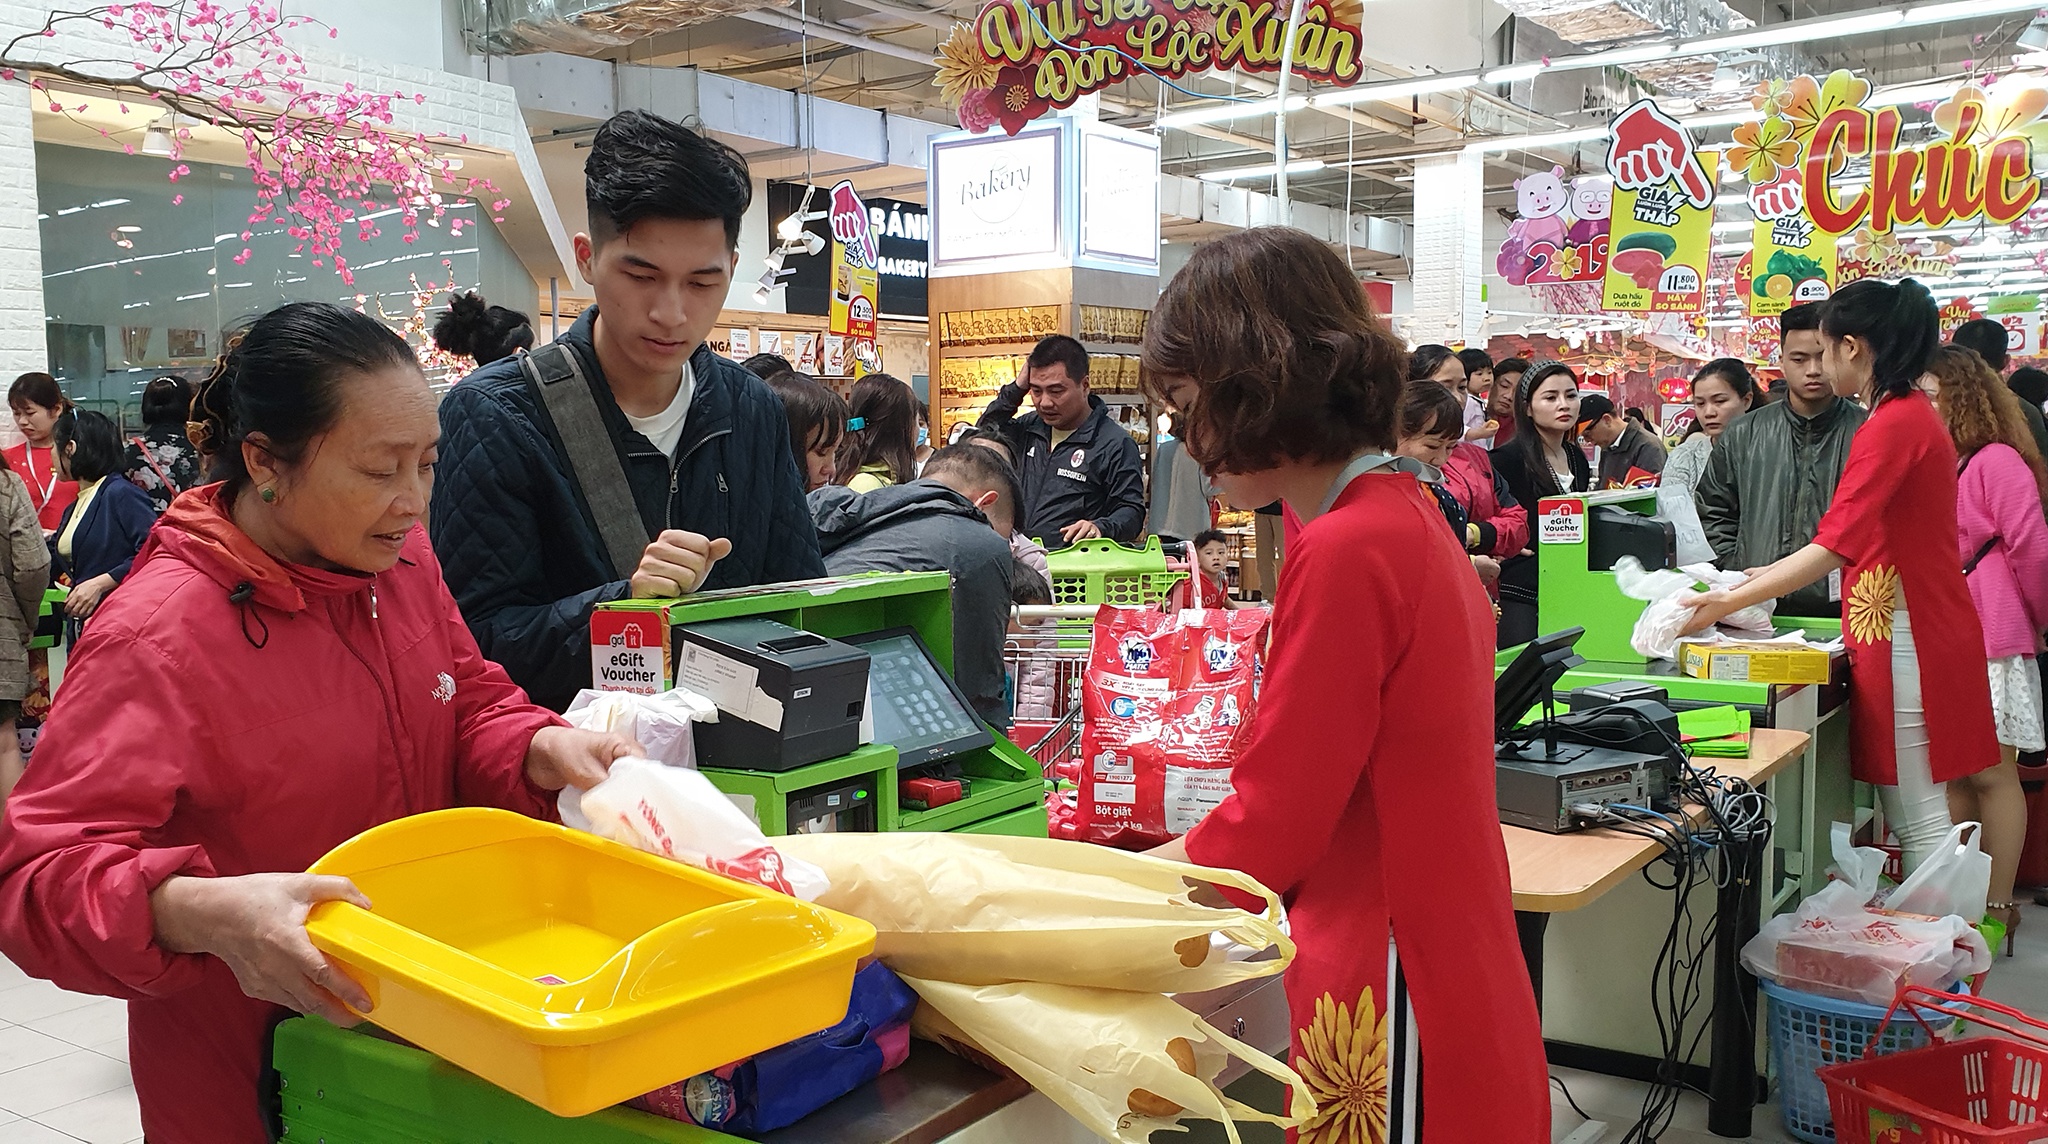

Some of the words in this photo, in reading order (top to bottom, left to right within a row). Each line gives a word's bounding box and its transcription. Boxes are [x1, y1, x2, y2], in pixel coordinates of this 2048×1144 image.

[1035, 40, 1123, 102] Đón
[1126, 14, 1211, 72] Lộc
[1216, 2, 1358, 77] Xuân
[1804, 104, 2040, 236] Chúc
[957, 165, 1031, 205] Bakery
[1639, 186, 1669, 204] GIÁ
[1635, 207, 1680, 227] THẤP
[1776, 216, 1801, 229] GIÁ
[1772, 232, 1812, 248] THẤP
[878, 256, 928, 278] BAKERY
[1525, 234, 1608, 285] 219
[1801, 287, 1810, 297] 8
[611, 635, 625, 648] got
[610, 653, 645, 667] eGift
[601, 667, 656, 682] Voucher
[1095, 804, 1111, 818] Bột
[1112, 805, 1132, 819] giặt
[1130, 821, 1143, 830] kg
[708, 1075, 722, 1122] ATSAN
